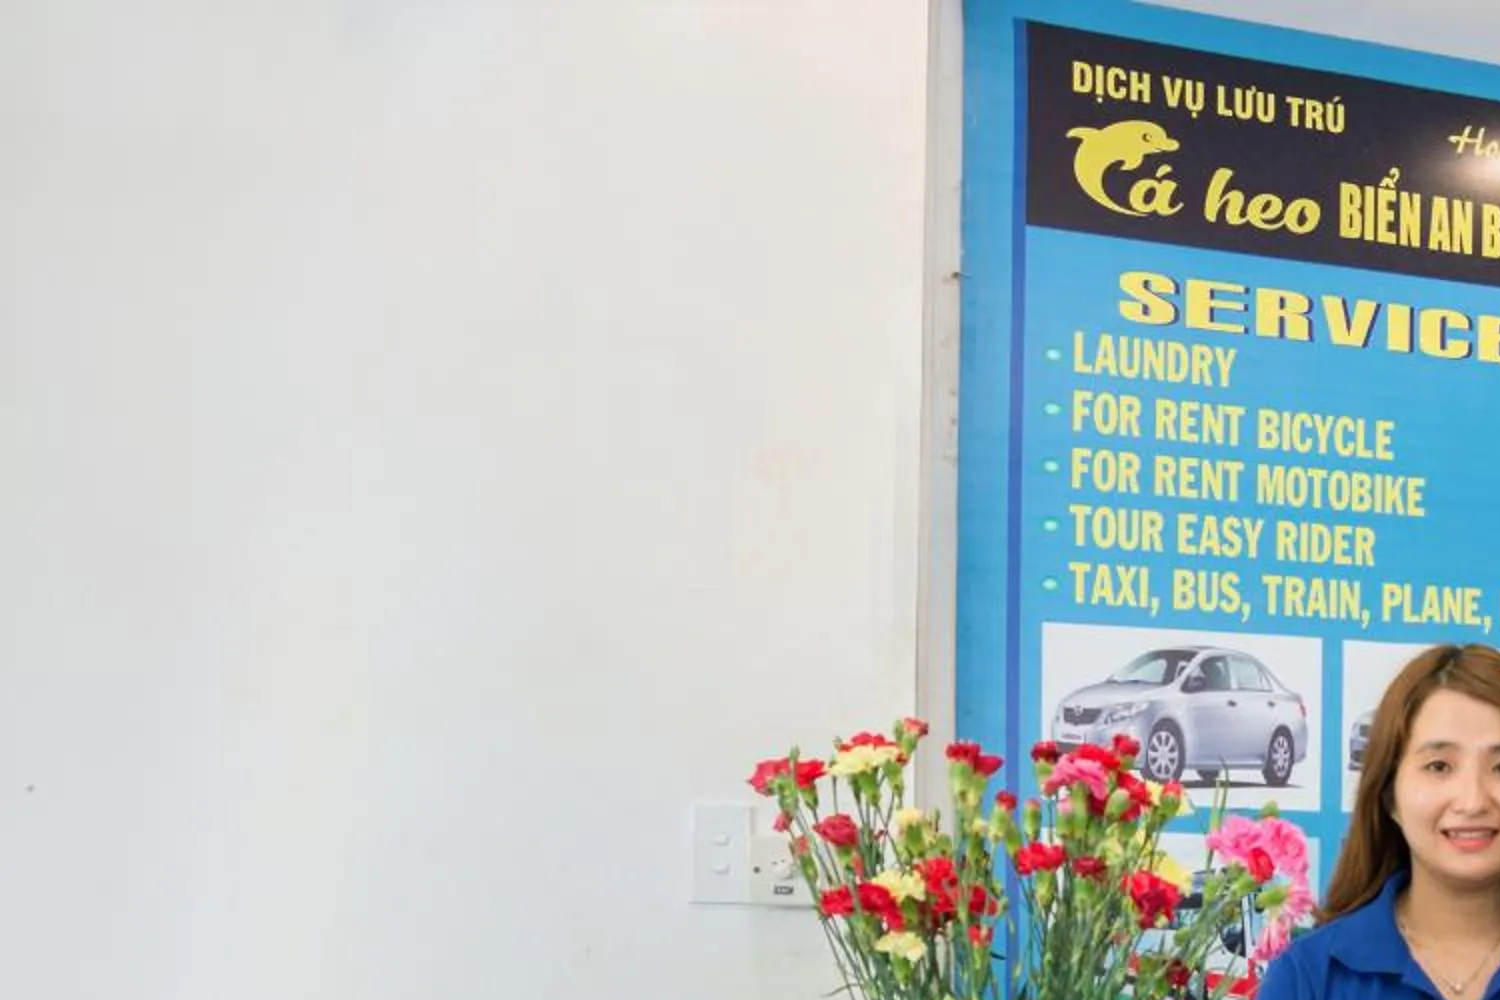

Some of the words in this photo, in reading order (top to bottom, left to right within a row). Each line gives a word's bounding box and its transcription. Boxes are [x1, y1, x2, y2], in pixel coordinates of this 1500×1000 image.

[1072, 61, 1151, 104] DỊCH
[1163, 78, 1205, 117] VỤ
[1217, 85, 1276, 120] LƯU
[1286, 95, 1346, 134] TRÚ
[1204, 167, 1321, 235] heo
[1339, 168, 1421, 249] BIỂN
[1428, 197, 1474, 256] AN
[1072, 330, 1237, 387] LAUNDRY
[1070, 389, 1141, 438] FOR
[1153, 397, 1246, 447] RENT
[1257, 409, 1395, 460] BICYCLE
[1070, 447, 1141, 495] FOR
[1153, 454, 1244, 505] RENT
[1256, 464, 1426, 518] MOTOBIKE
[1068, 504, 1164, 553] TOUR
[1176, 514, 1264, 559] EASY
[1275, 520, 1377, 567] RIDER
[1068, 561, 1161, 617] TAXI,
[1172, 569, 1253, 623] BUS,
[1262, 574, 1371, 629] TRAIN,
[1381, 583, 1492, 634] PLANE,
